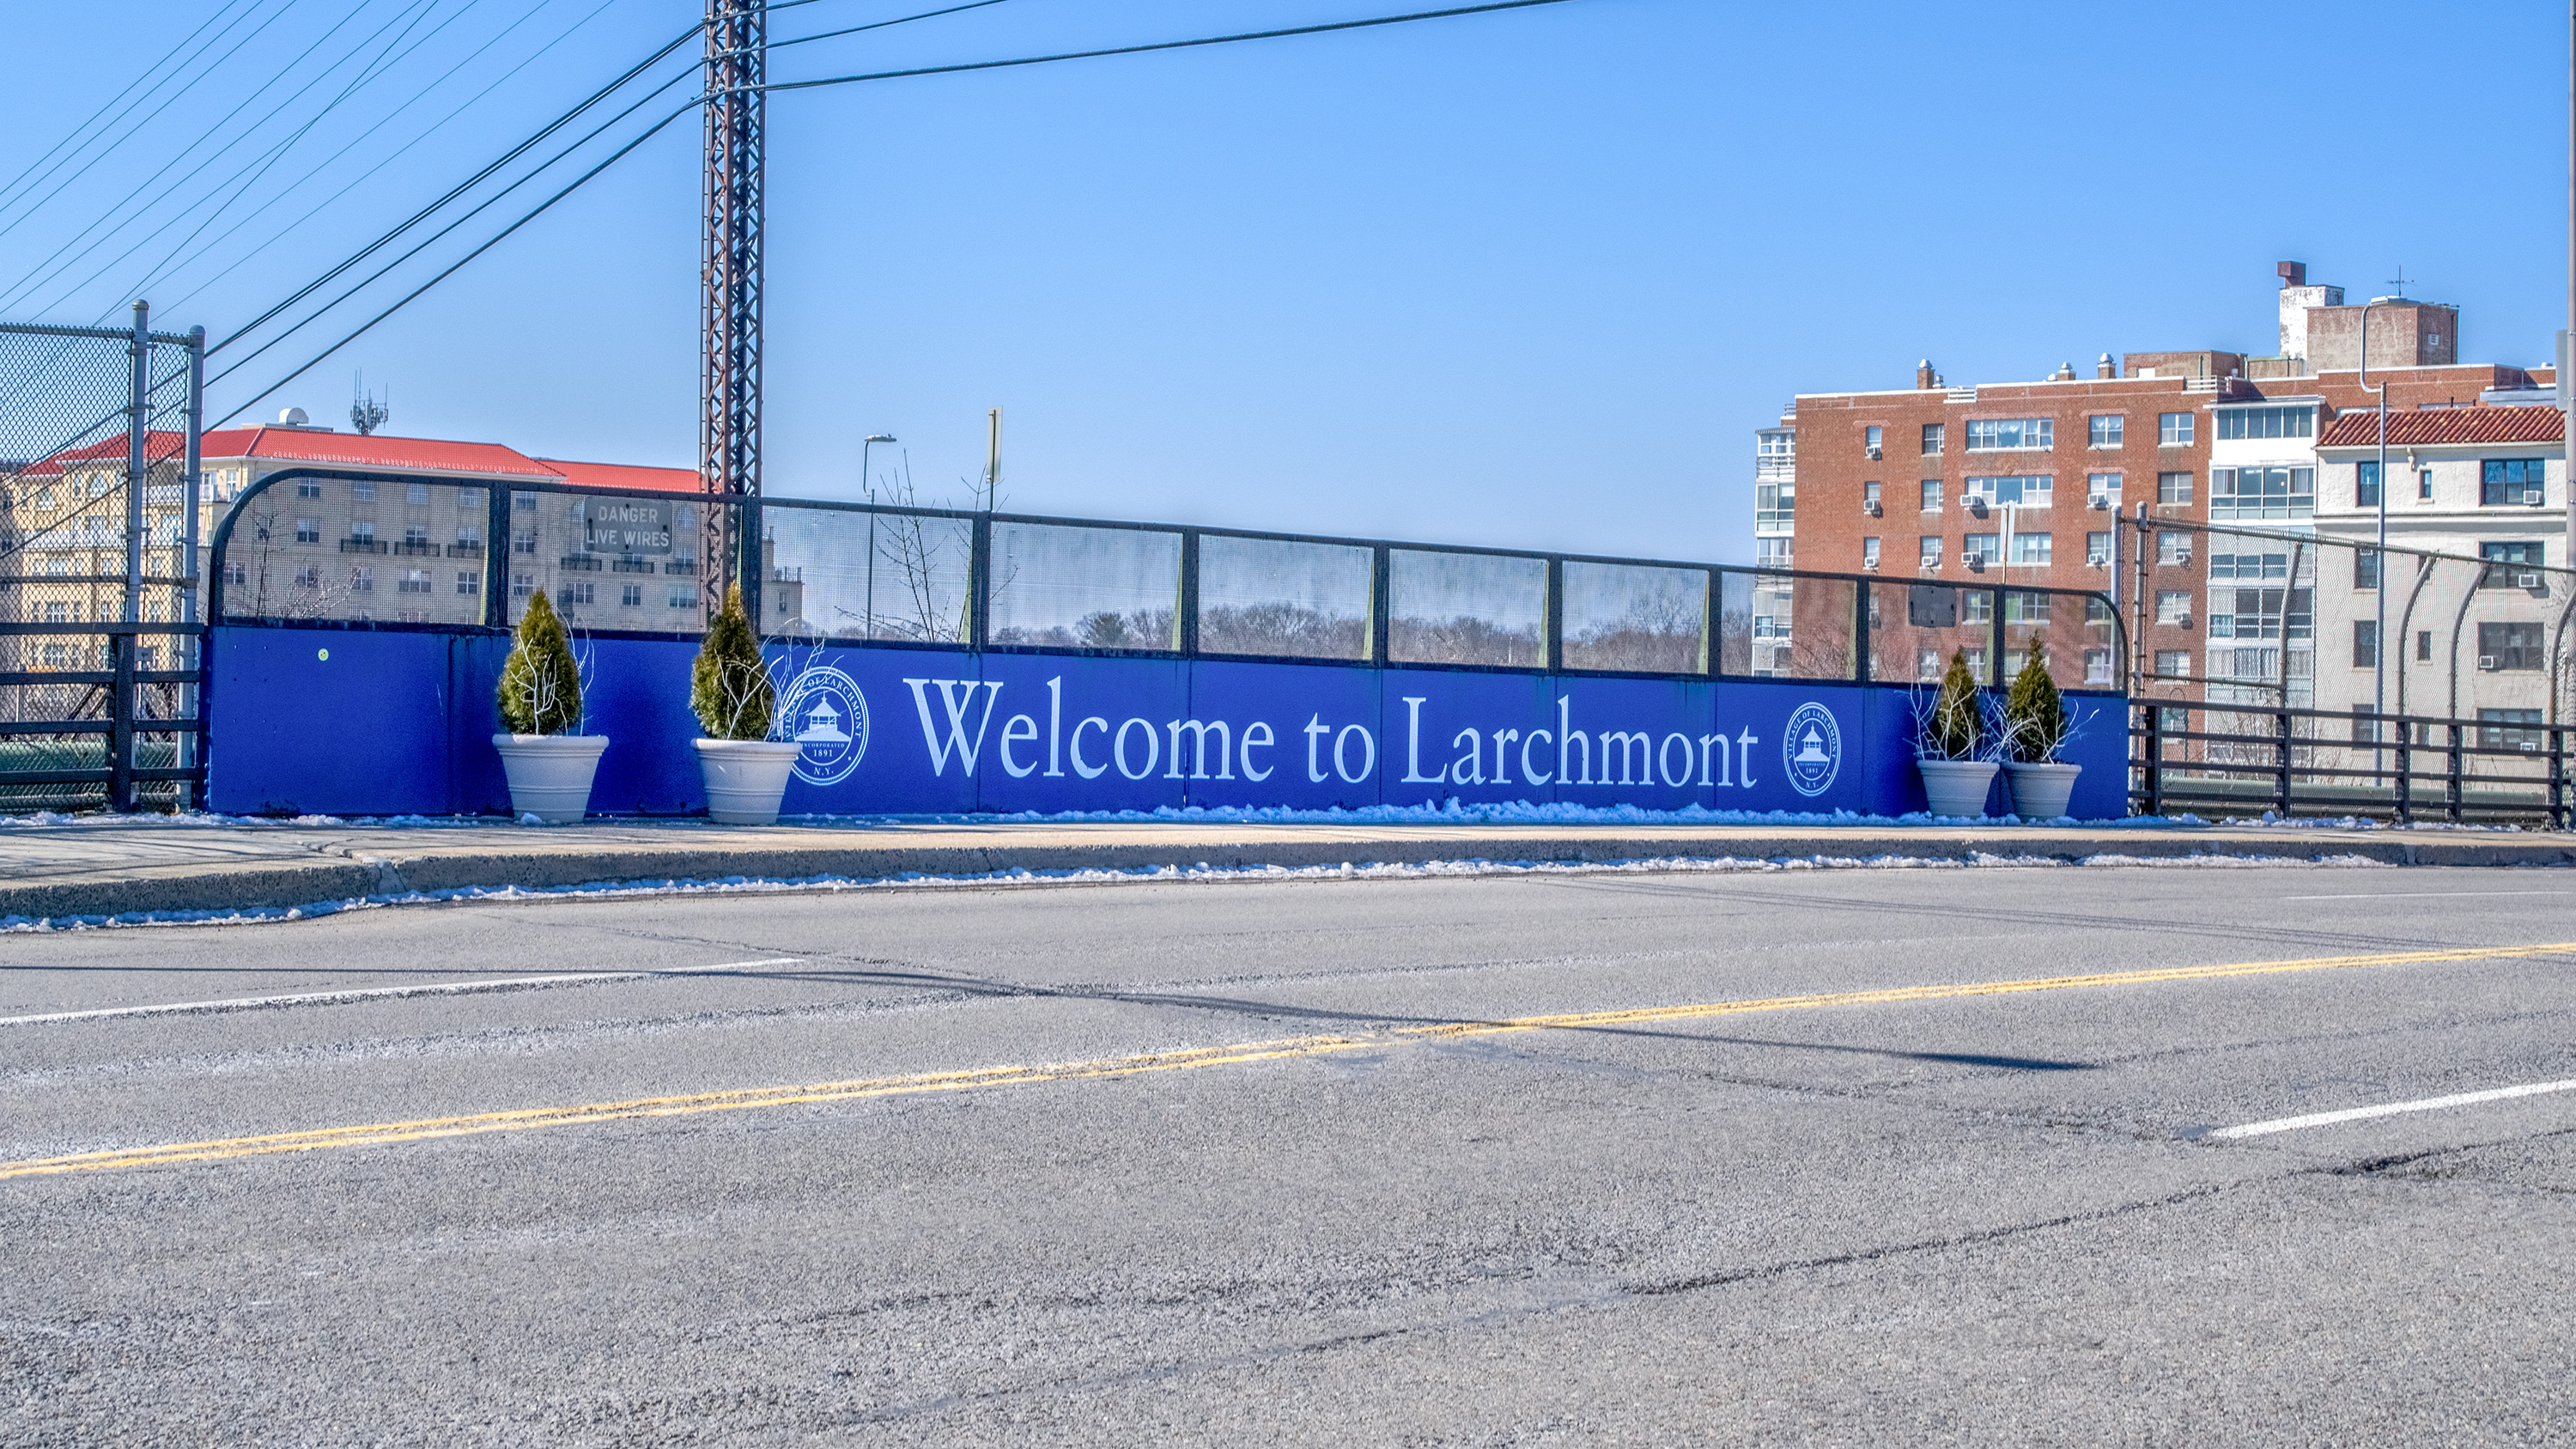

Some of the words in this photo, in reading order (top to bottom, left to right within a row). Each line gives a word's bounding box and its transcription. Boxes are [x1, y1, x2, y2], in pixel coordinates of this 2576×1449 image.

[598, 506, 659, 523] DANGER
[586, 528, 617, 545] LIVE
[623, 531, 670, 546] WIRES
[808, 676, 820, 687] OF
[824, 676, 862, 739] LARCHMONT
[902, 675, 1274, 782] Welcome
[1303, 712, 1376, 783] to
[1400, 694, 1759, 788] Larchmont
[1788, 716, 1801, 760] VILLAGE
[1802, 710, 1810, 719] OF
[1813, 709, 1837, 758] LARCHMONT
[814, 767, 833, 776] N.Y.
